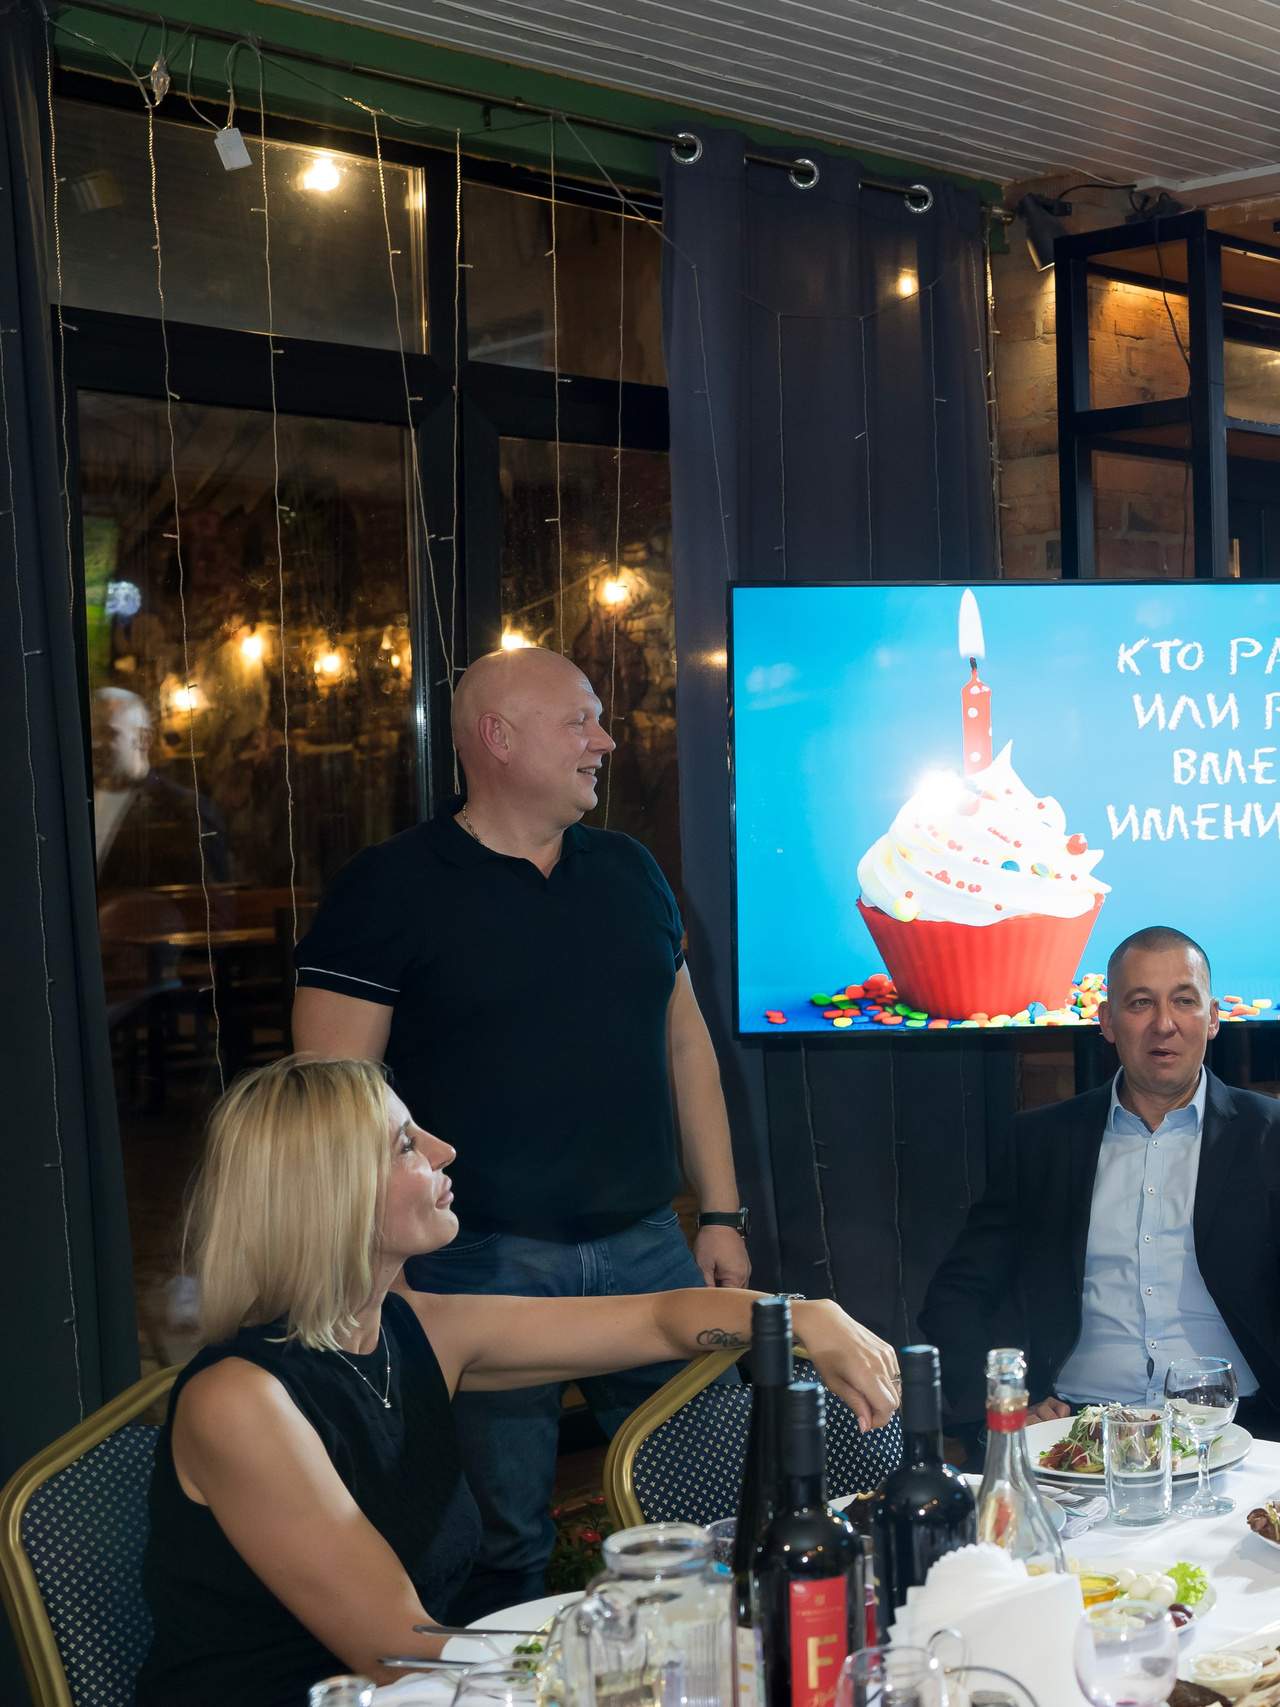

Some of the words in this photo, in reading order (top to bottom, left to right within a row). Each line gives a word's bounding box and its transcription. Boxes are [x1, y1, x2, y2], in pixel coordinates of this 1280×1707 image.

[1117, 637, 1206, 676] КТО
[1132, 692, 1240, 731] ИЛИ
[807, 1634, 838, 1689] F
